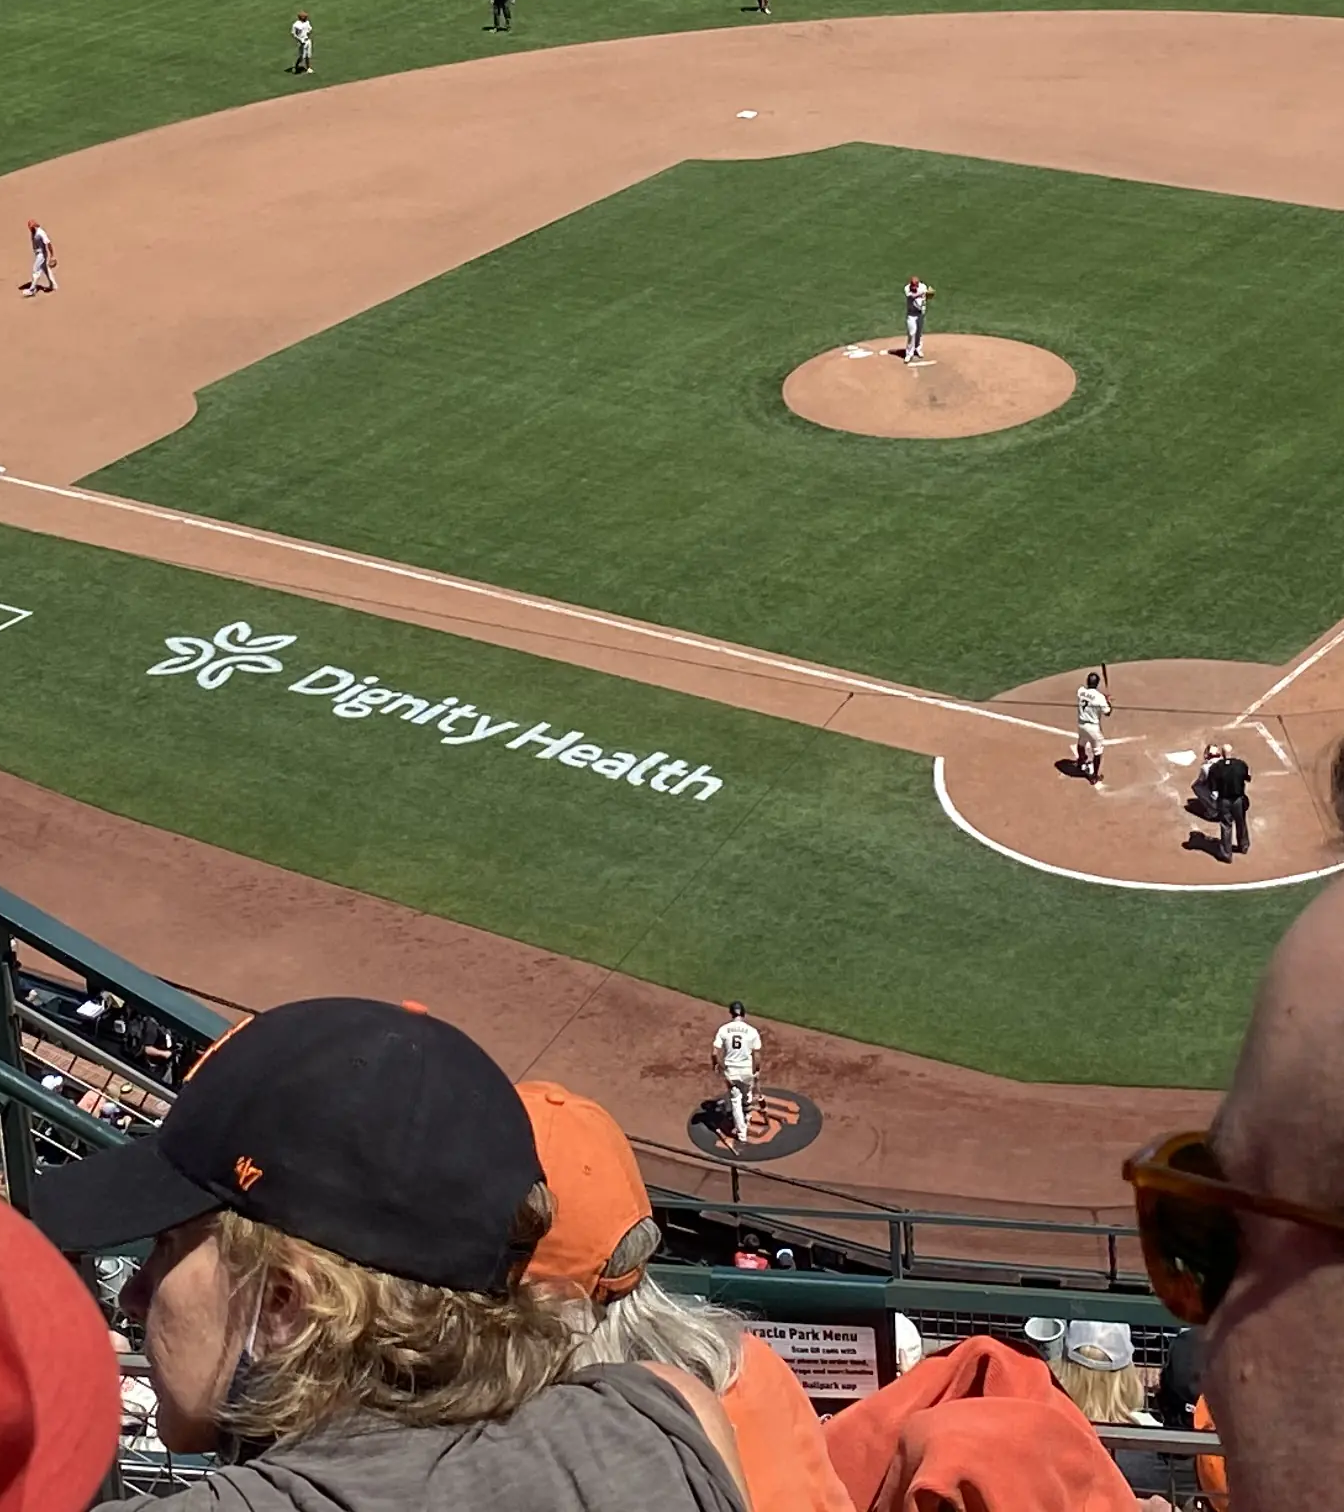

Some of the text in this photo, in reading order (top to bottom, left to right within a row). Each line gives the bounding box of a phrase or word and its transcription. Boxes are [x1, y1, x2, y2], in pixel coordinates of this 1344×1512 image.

[288, 664, 724, 802] Dignity Health
[732, 1035, 742, 1050] 6
[789, 1327, 820, 1341] Park
[823, 1330, 858, 1342] Menu
